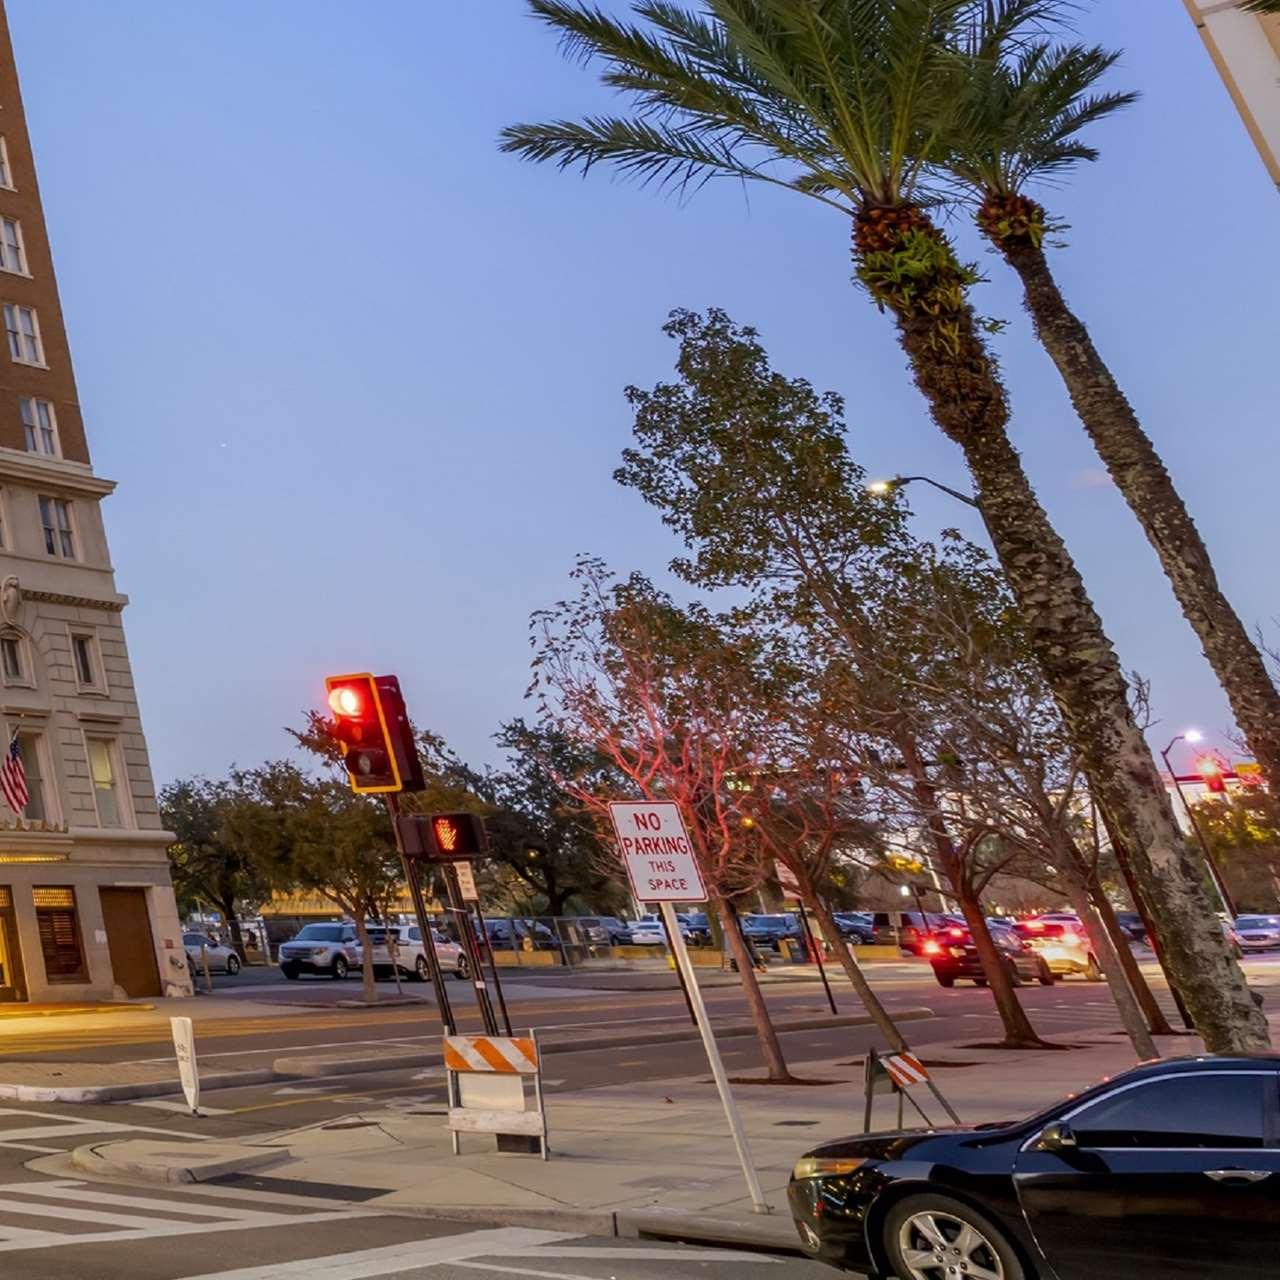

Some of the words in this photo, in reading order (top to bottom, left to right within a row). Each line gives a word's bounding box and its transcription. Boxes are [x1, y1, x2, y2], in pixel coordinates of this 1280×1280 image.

[633, 812, 661, 831] NO
[622, 836, 688, 855] PARKING
[648, 860, 675, 873] THIS
[648, 878, 688, 891] SPACE
